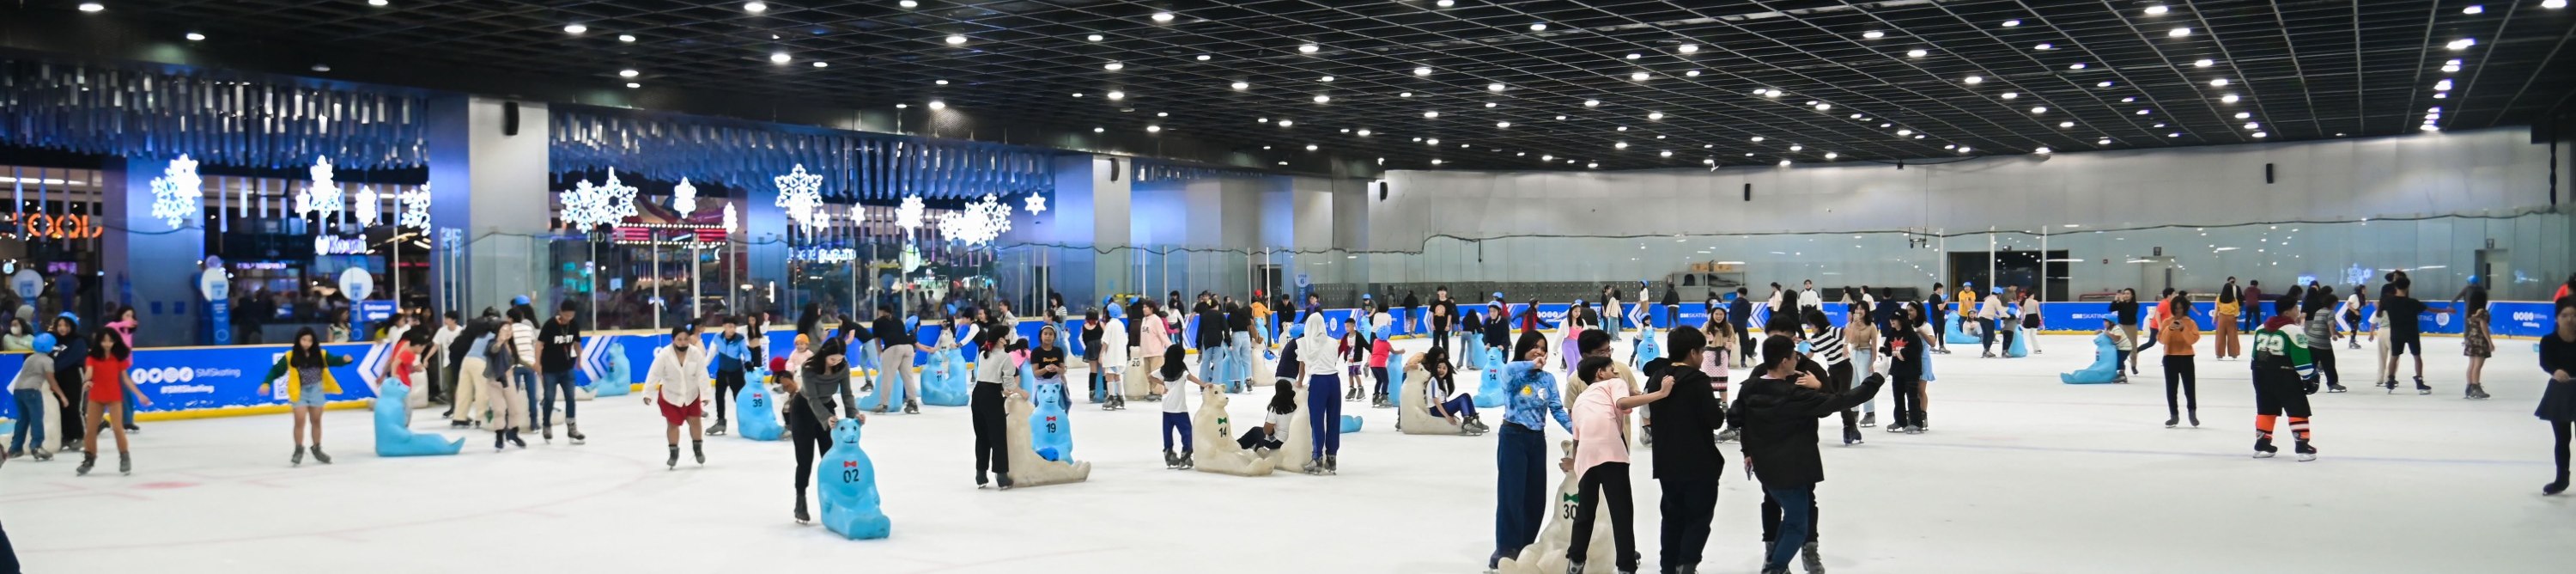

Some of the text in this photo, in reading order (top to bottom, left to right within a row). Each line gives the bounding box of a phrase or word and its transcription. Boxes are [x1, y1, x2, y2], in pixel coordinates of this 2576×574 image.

[195, 368, 241, 378] SMSkating
[752, 399, 763, 407] 39
[1046, 423, 1056, 433] 19
[1218, 426, 1227, 438] 14
[843, 468, 860, 484] 02
[1563, 504, 1579, 520] 30
